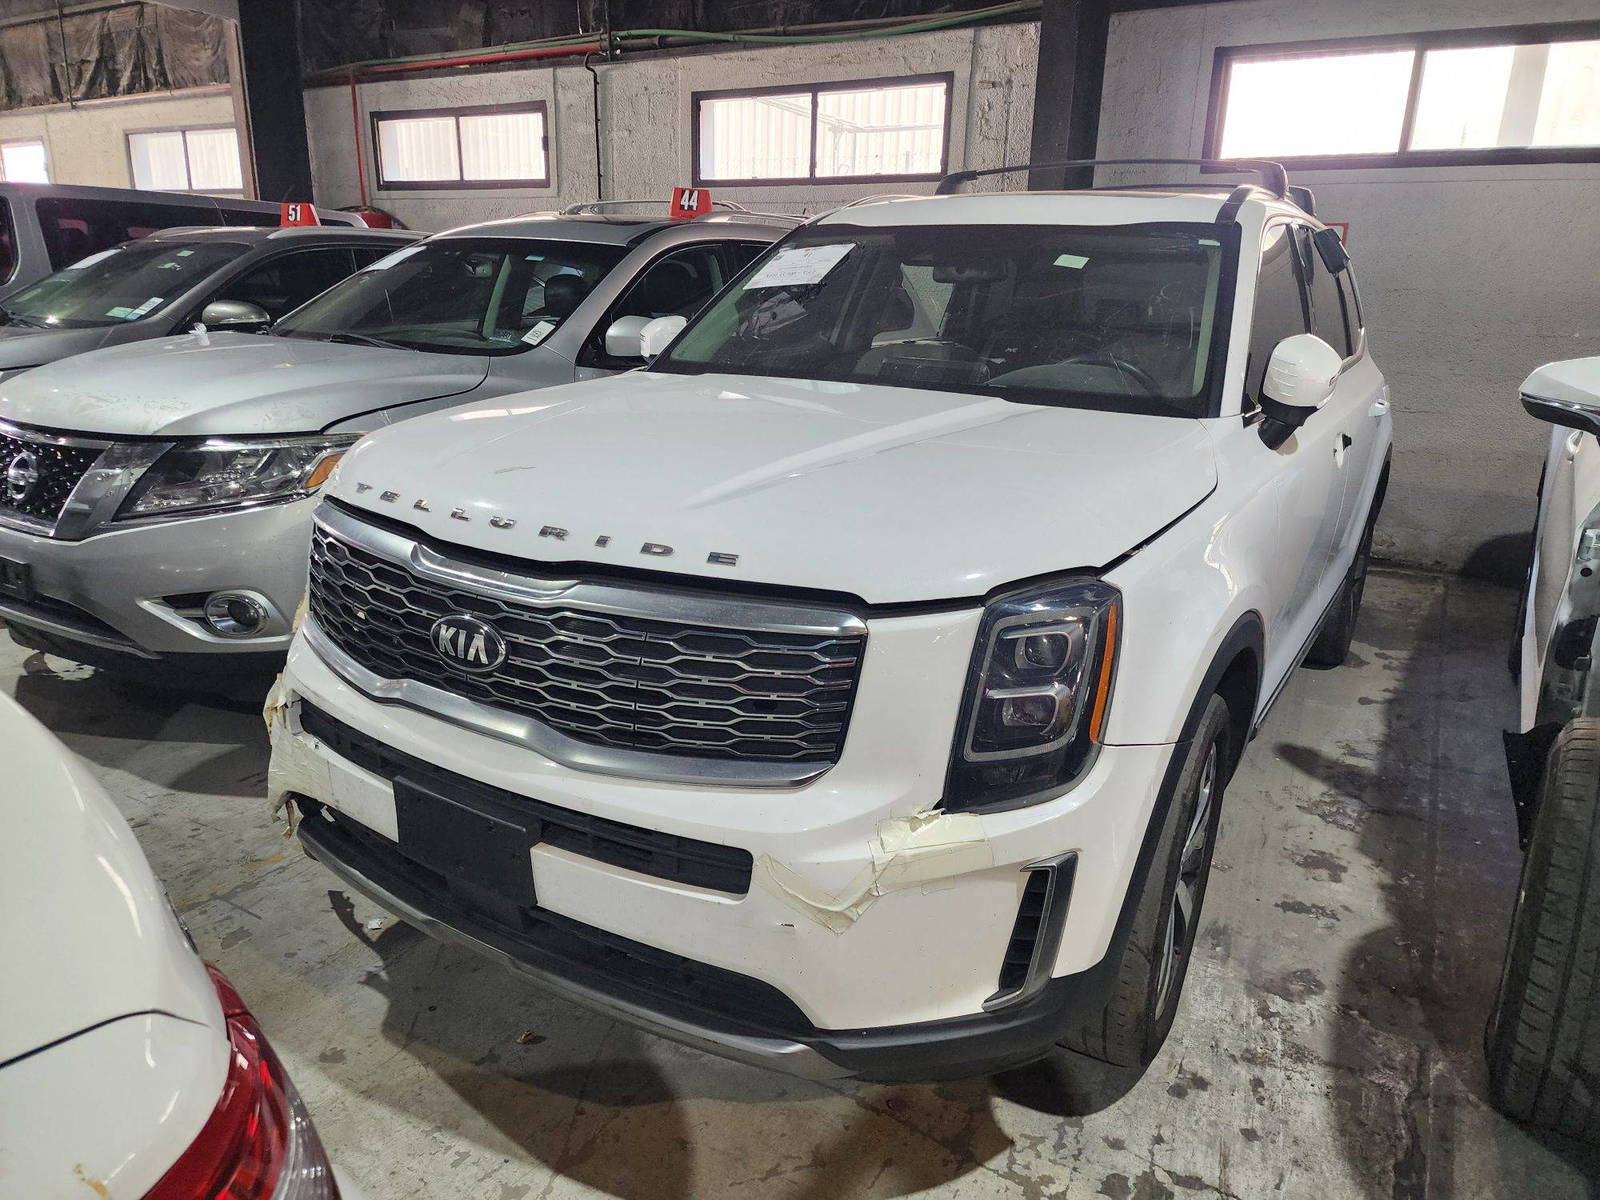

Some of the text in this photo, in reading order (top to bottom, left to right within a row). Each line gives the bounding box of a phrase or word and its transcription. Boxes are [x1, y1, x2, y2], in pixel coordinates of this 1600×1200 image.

[288, 204, 301, 221] 51
[681, 190, 698, 210] 44
[356, 482, 740, 567] TELLURIDE
[439, 624, 489, 664] KIA
